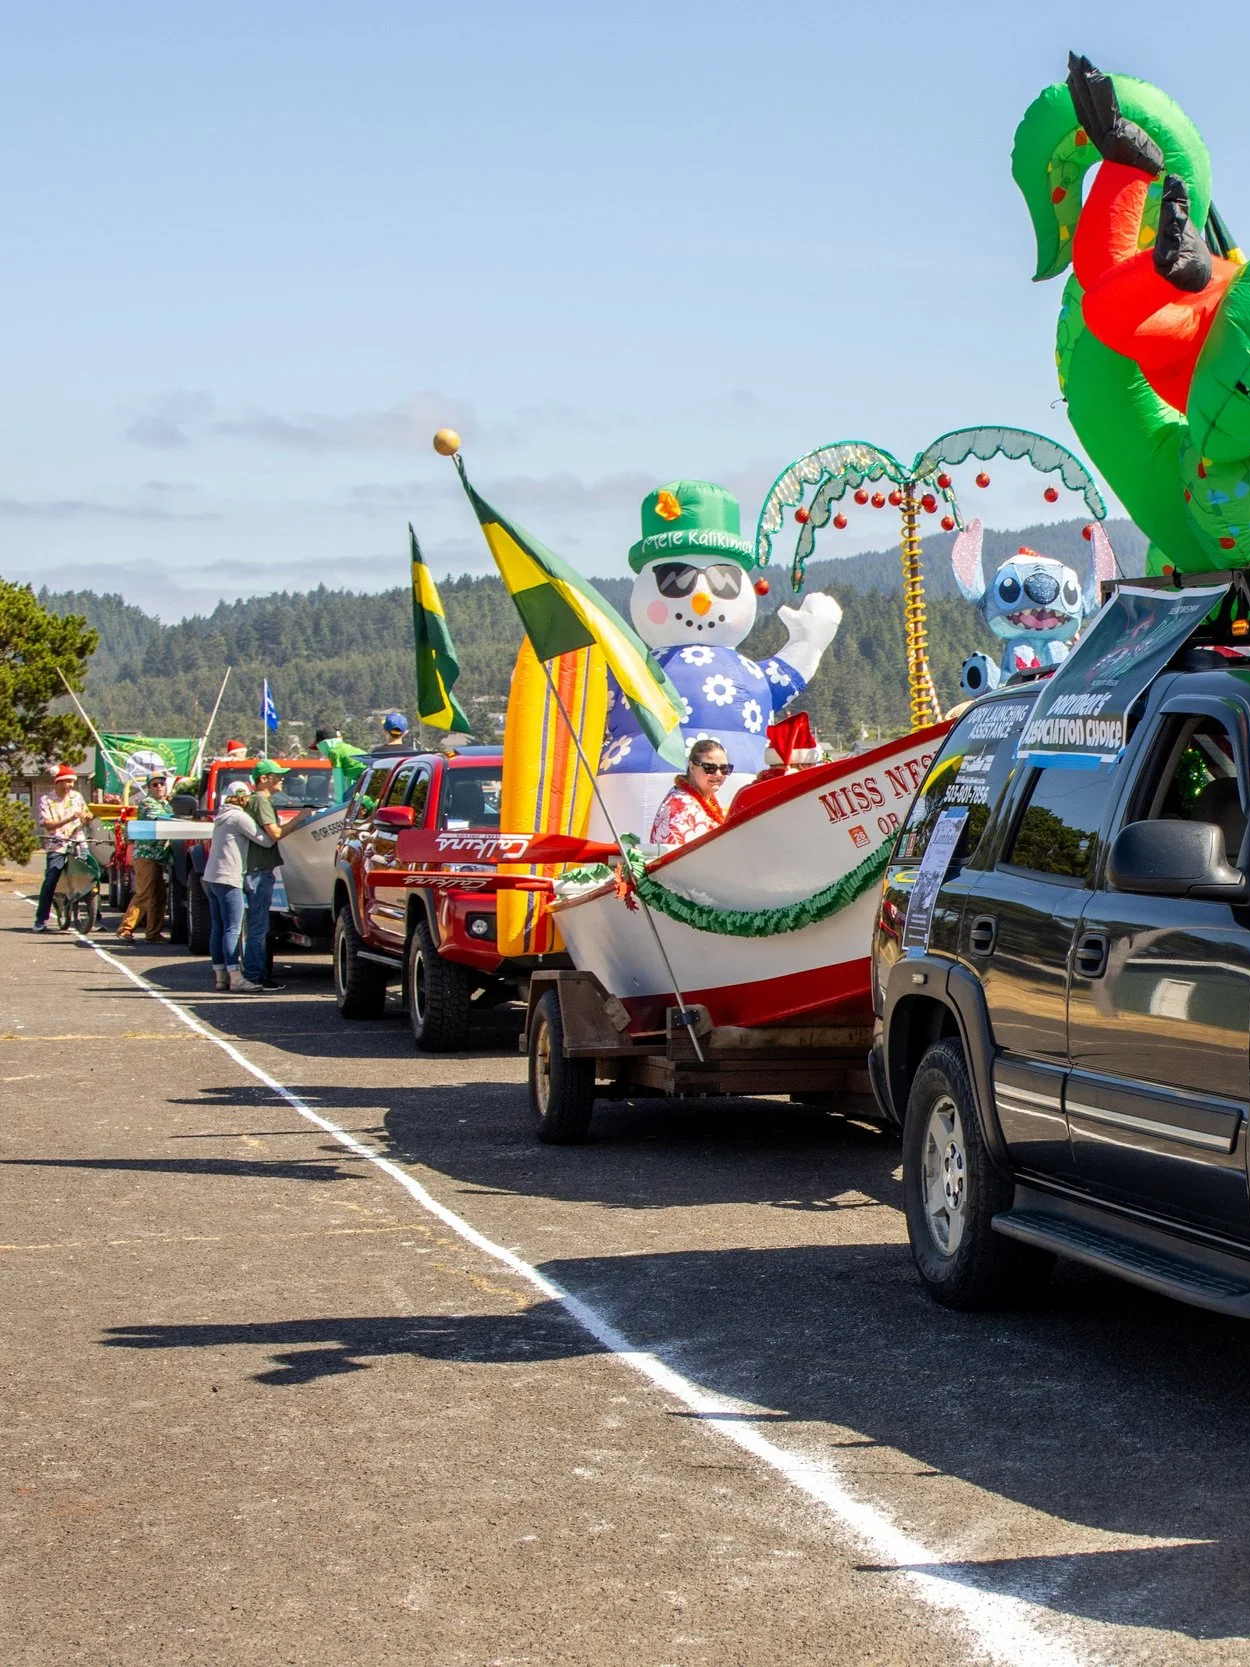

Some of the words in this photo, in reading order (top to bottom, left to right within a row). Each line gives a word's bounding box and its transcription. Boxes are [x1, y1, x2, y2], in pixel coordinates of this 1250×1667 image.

[642, 531, 682, 553] Mele
[968, 721, 1014, 740] ASSISTANCE
[818, 776, 886, 824] MISS
[435, 838, 530, 859] Calkins
